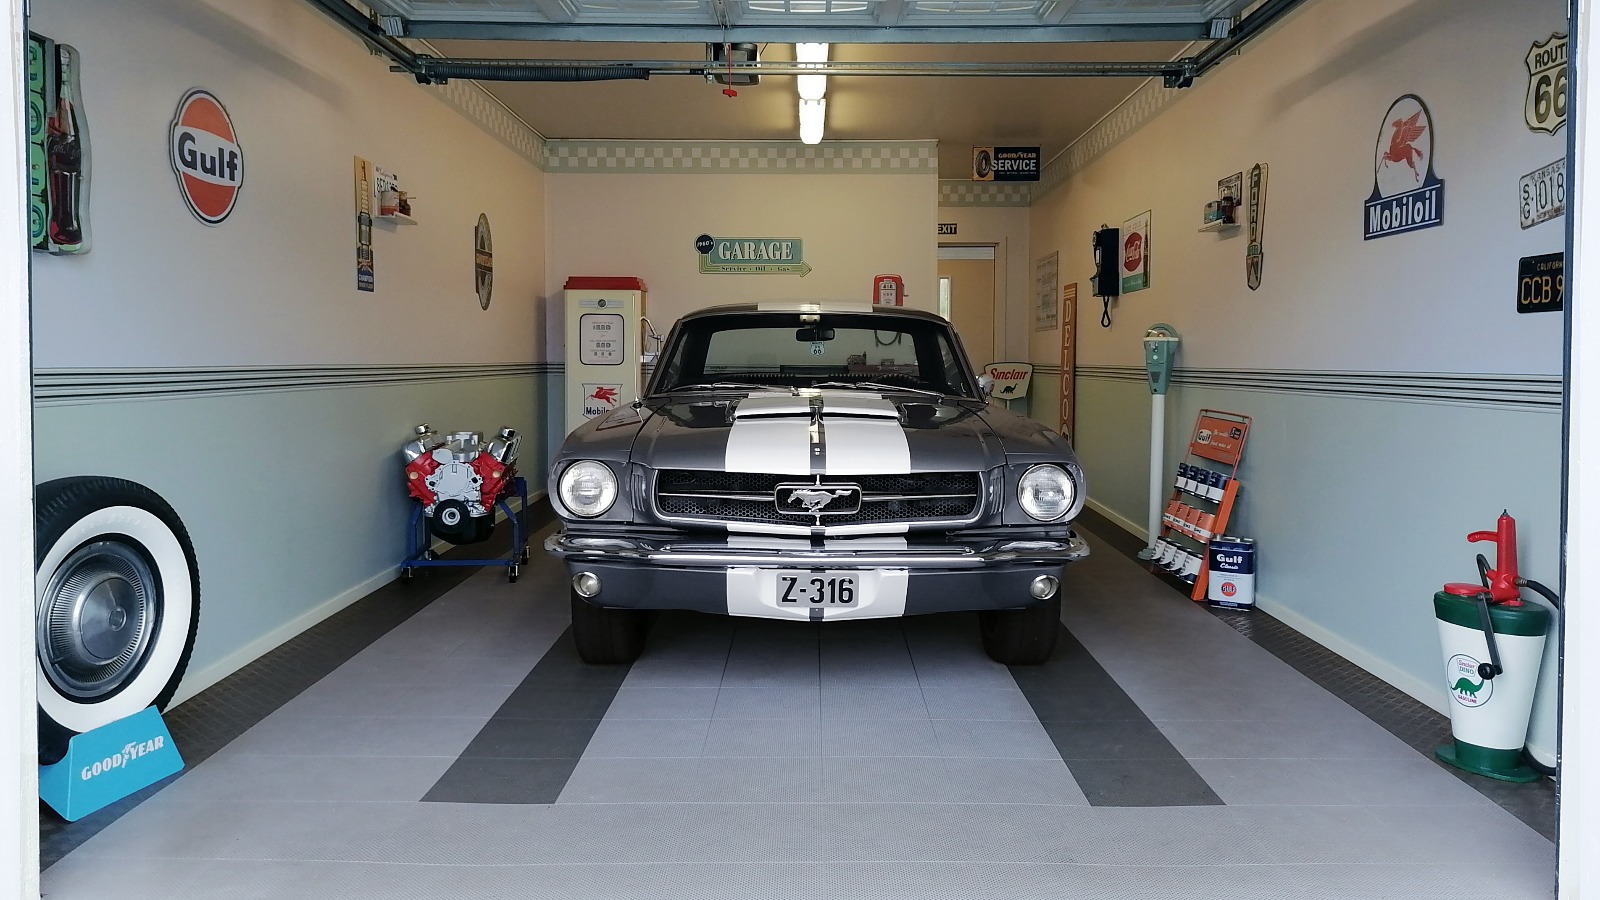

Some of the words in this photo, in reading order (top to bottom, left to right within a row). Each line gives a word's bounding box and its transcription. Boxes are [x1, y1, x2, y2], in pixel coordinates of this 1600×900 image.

[1534, 67, 1567, 123] 66
[178, 131, 238, 181] Gulf
[991, 159, 1037, 170] SERVICE
[1530, 164, 1561, 183] KANSAS
[1250, 169, 1260, 240] FORD
[1369, 191, 1436, 233] Mobiloil
[938, 224, 957, 234] EXIT
[718, 241, 793, 260] GARAGE
[1521, 276, 1552, 304] CCB
[1062, 299, 1072, 421] DELCO
[991, 368, 1028, 380] Sinclair
[1198, 431, 1211, 442] Gulf
[1216, 554, 1243, 564] Gulf
[781, 577, 854, 603] Z-316
[1459, 666, 1475, 674] DINO
[81, 736, 164, 780] GOODYEAR
